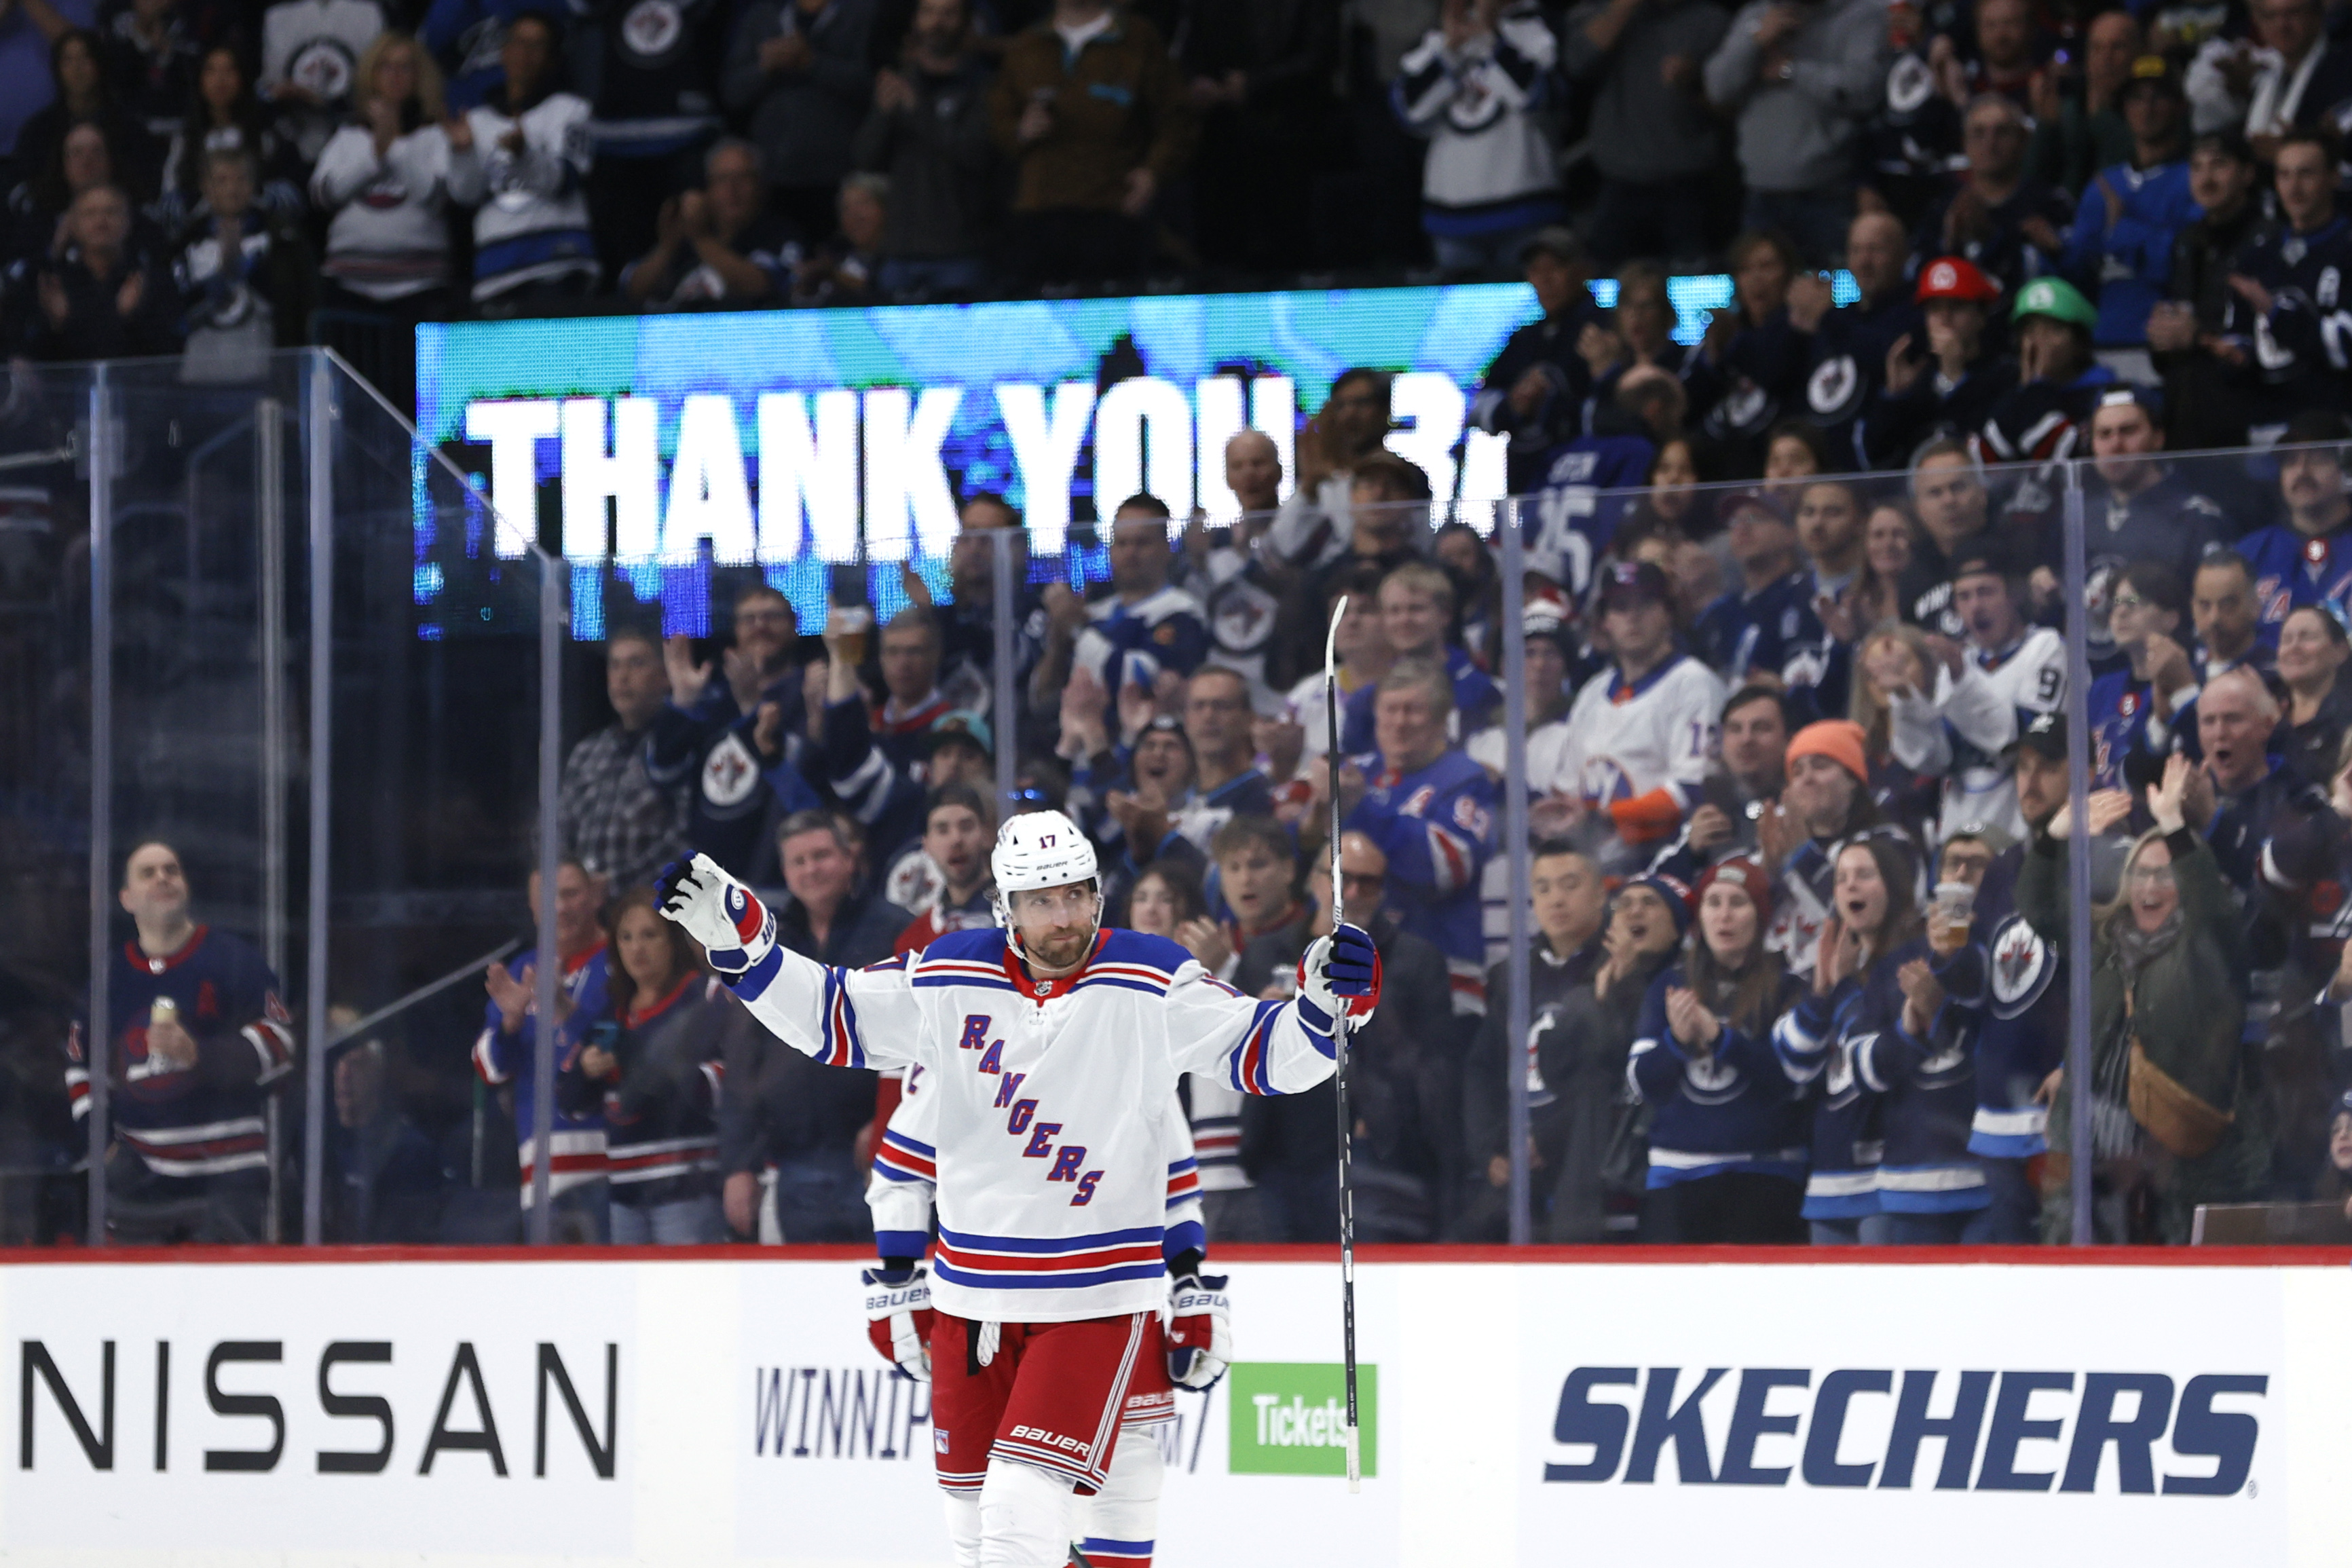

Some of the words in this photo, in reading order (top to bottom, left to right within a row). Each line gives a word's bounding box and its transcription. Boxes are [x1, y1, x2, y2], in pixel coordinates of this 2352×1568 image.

[466, 386, 964, 566] THANK
[993, 373, 1295, 558] YOU
[1036, 861, 1068, 871] BAUER
[1039, 834, 1056, 849] 17
[958, 1014, 1106, 1207] RANGERS
[20, 1340, 618, 1480] NISSAN
[1009, 1424, 1091, 1458] BAUER
[1252, 1394, 1349, 1448] Tickets
[1544, 1366, 2269, 1497] SKECHERS
